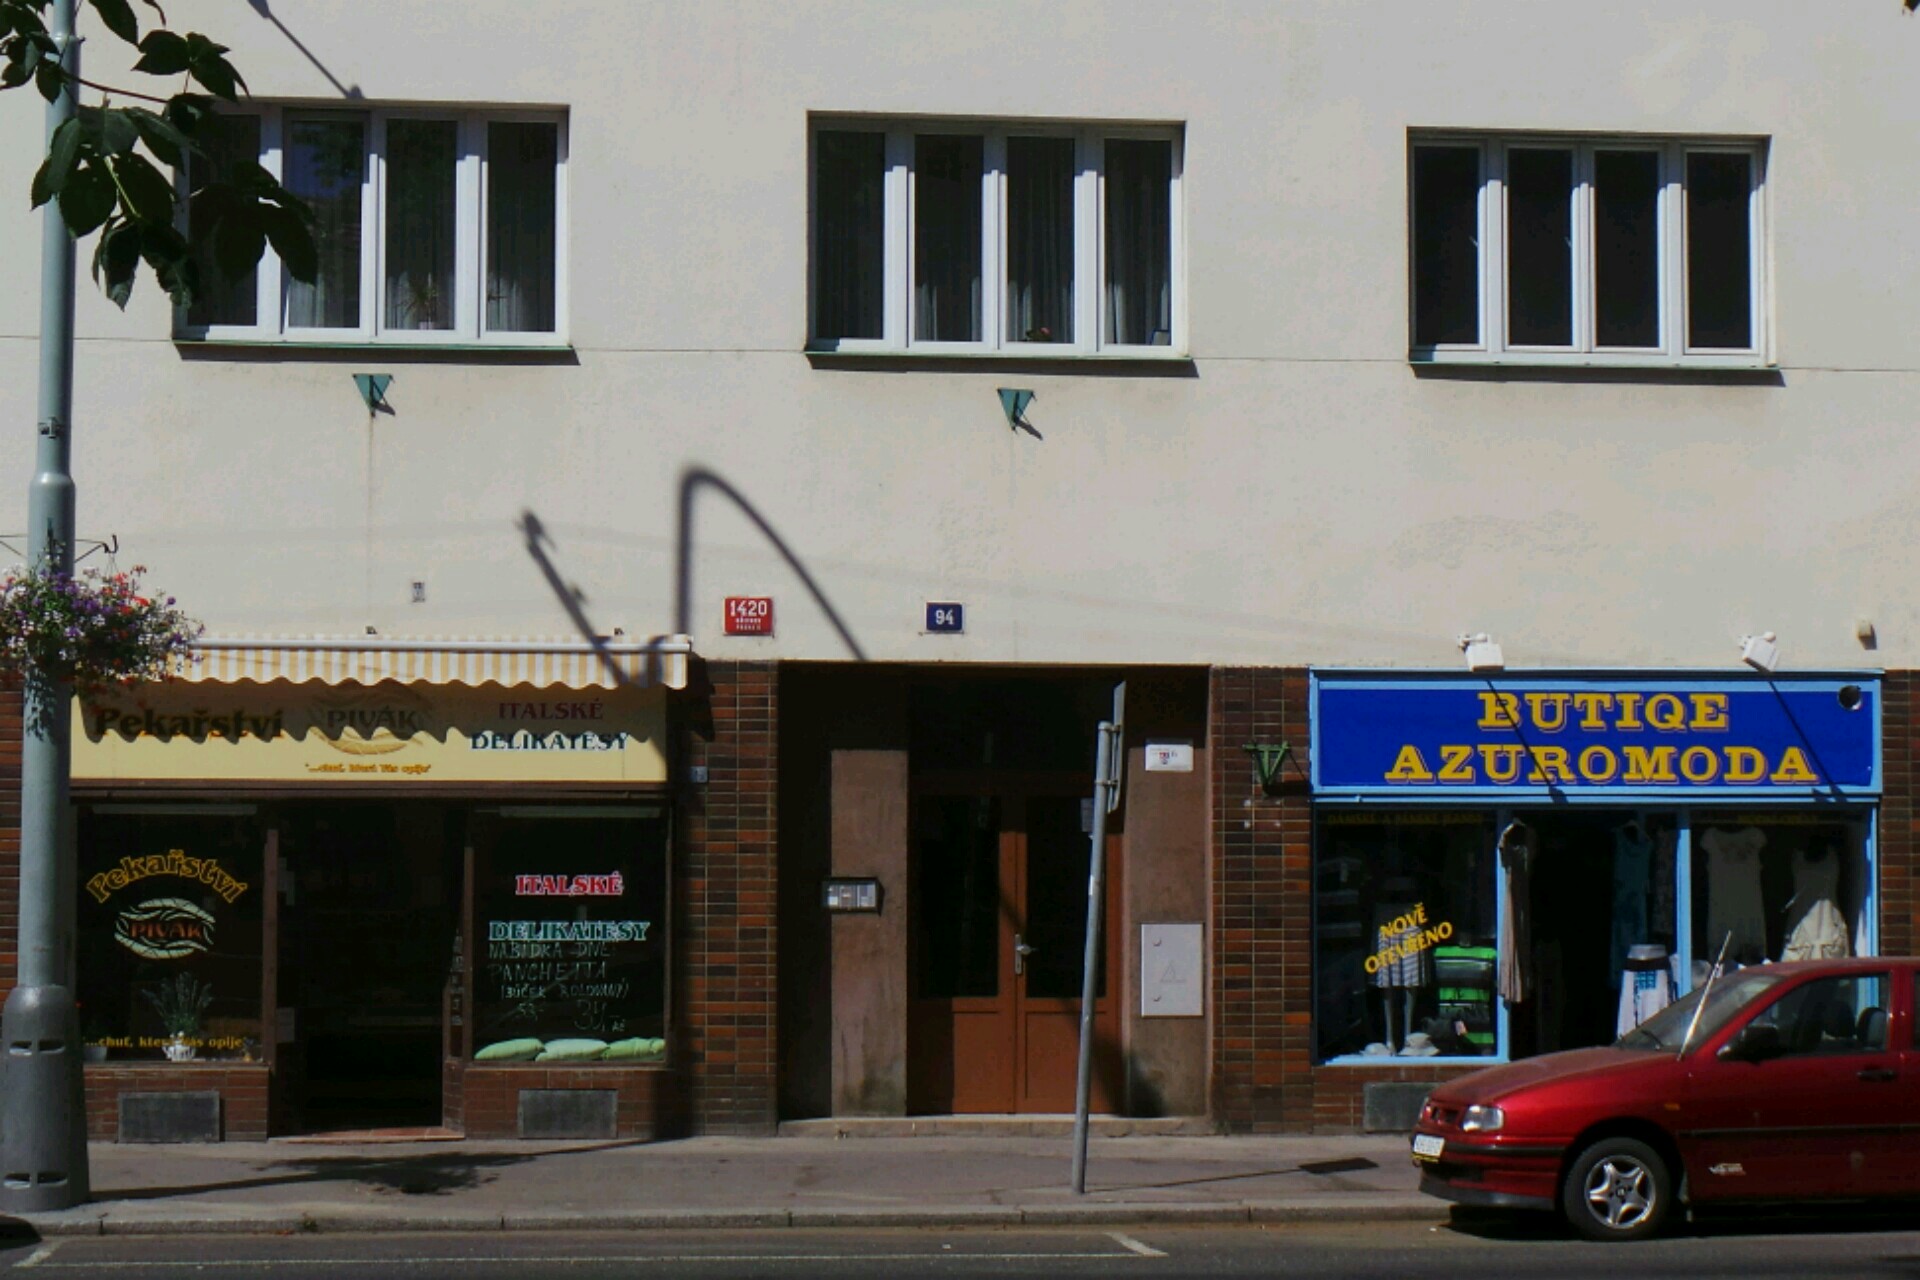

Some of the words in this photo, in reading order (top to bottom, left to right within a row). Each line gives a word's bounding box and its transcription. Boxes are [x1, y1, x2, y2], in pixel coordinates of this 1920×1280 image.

[730, 600, 767, 617] 1420
[936, 608, 954, 625] 94
[328, 705, 417, 730] PIVÁK
[498, 697, 604, 719] ITALSKÉ
[1477, 692, 1728, 731] BUTIQE
[95, 708, 283, 738] Pekařství
[471, 731, 629, 751] DELIKATESY
[1384, 745, 1818, 783] AZUROMODA
[86, 849, 248, 903] Pekařství
[515, 870, 624, 896] ITALSKÉ
[489, 921, 650, 941] DELIKATESY
[1379, 902, 1428, 937] NOVĚ
